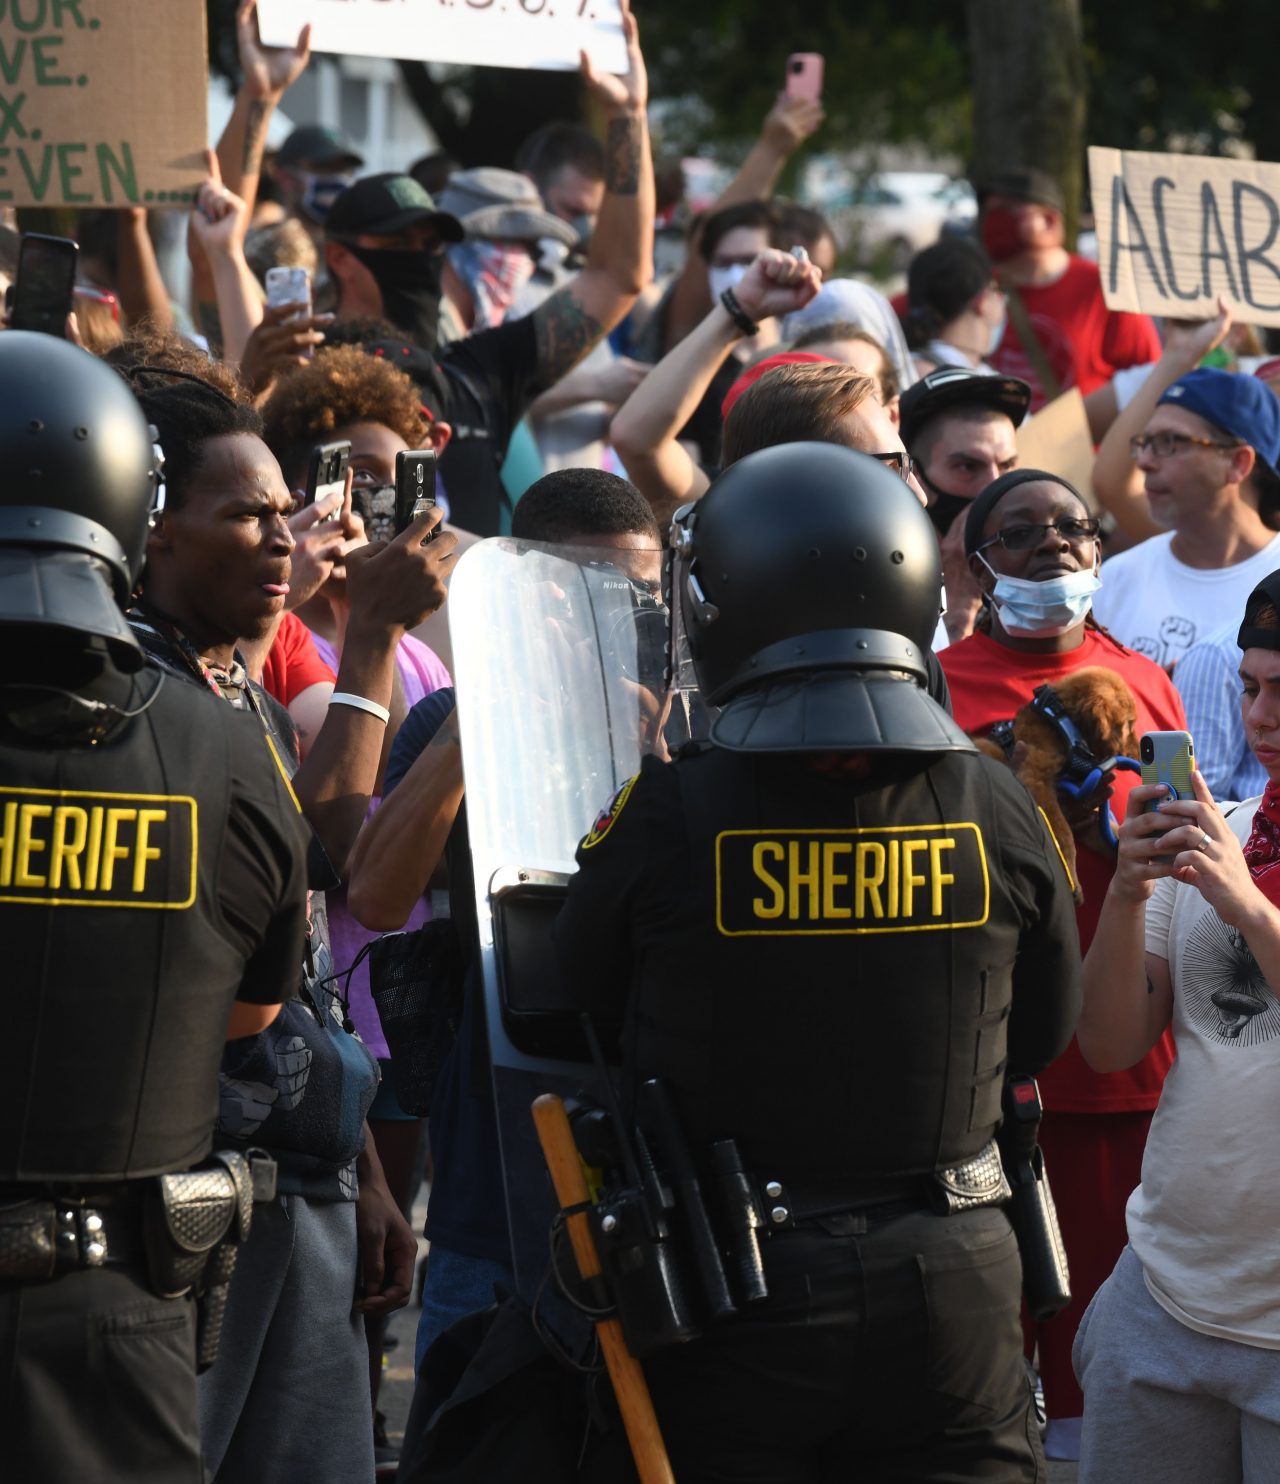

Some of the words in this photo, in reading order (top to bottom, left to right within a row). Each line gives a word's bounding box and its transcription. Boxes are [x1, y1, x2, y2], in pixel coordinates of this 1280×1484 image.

[0, 0, 100, 32] UR.
[603, 581, 629, 590] Nikon
[753, 838, 955, 919] SHERIFF
